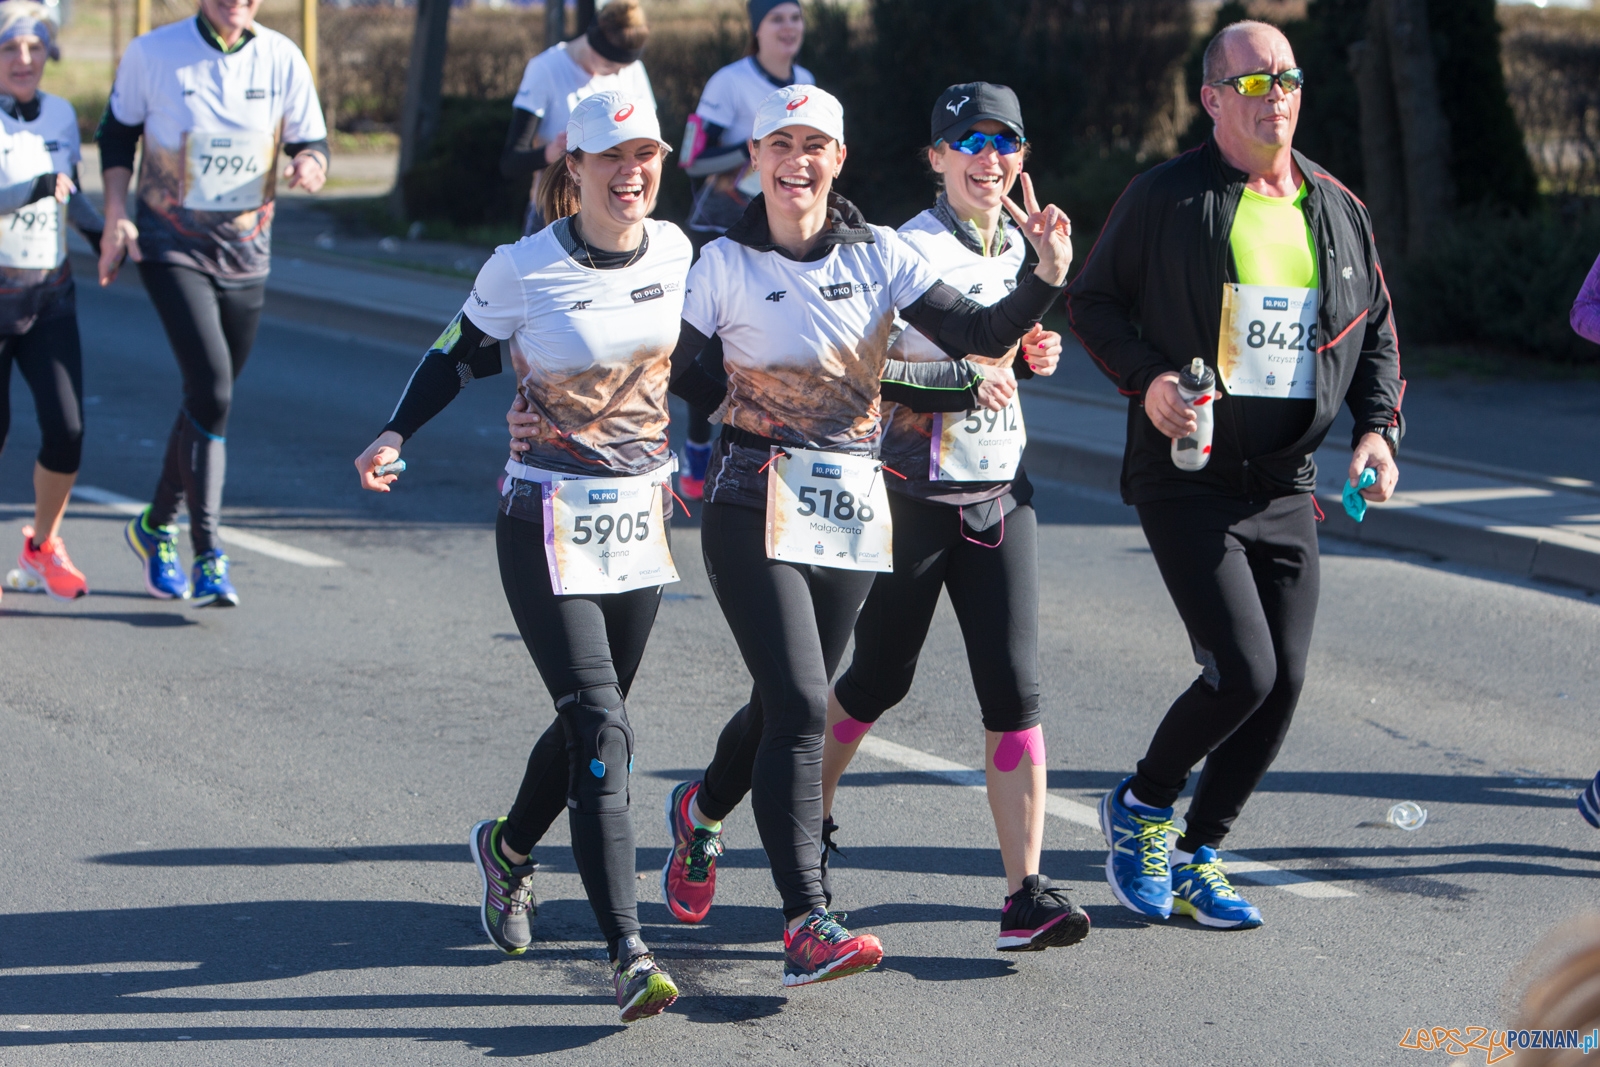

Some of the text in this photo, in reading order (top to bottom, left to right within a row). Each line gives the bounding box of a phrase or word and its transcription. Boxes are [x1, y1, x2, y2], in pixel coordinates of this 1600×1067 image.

[200, 154, 258, 175] 7994
[9, 211, 59, 231] 7993
[765, 290, 787, 302] 4F
[1246, 320, 1317, 352] 8428
[1268, 354, 1304, 364] Krzysztof
[964, 403, 1018, 434] 5912
[796, 486, 875, 522] 5188
[571, 511, 650, 545] 5905
[809, 522, 862, 534] Małgorzata
[598, 549, 630, 558] Joanna
